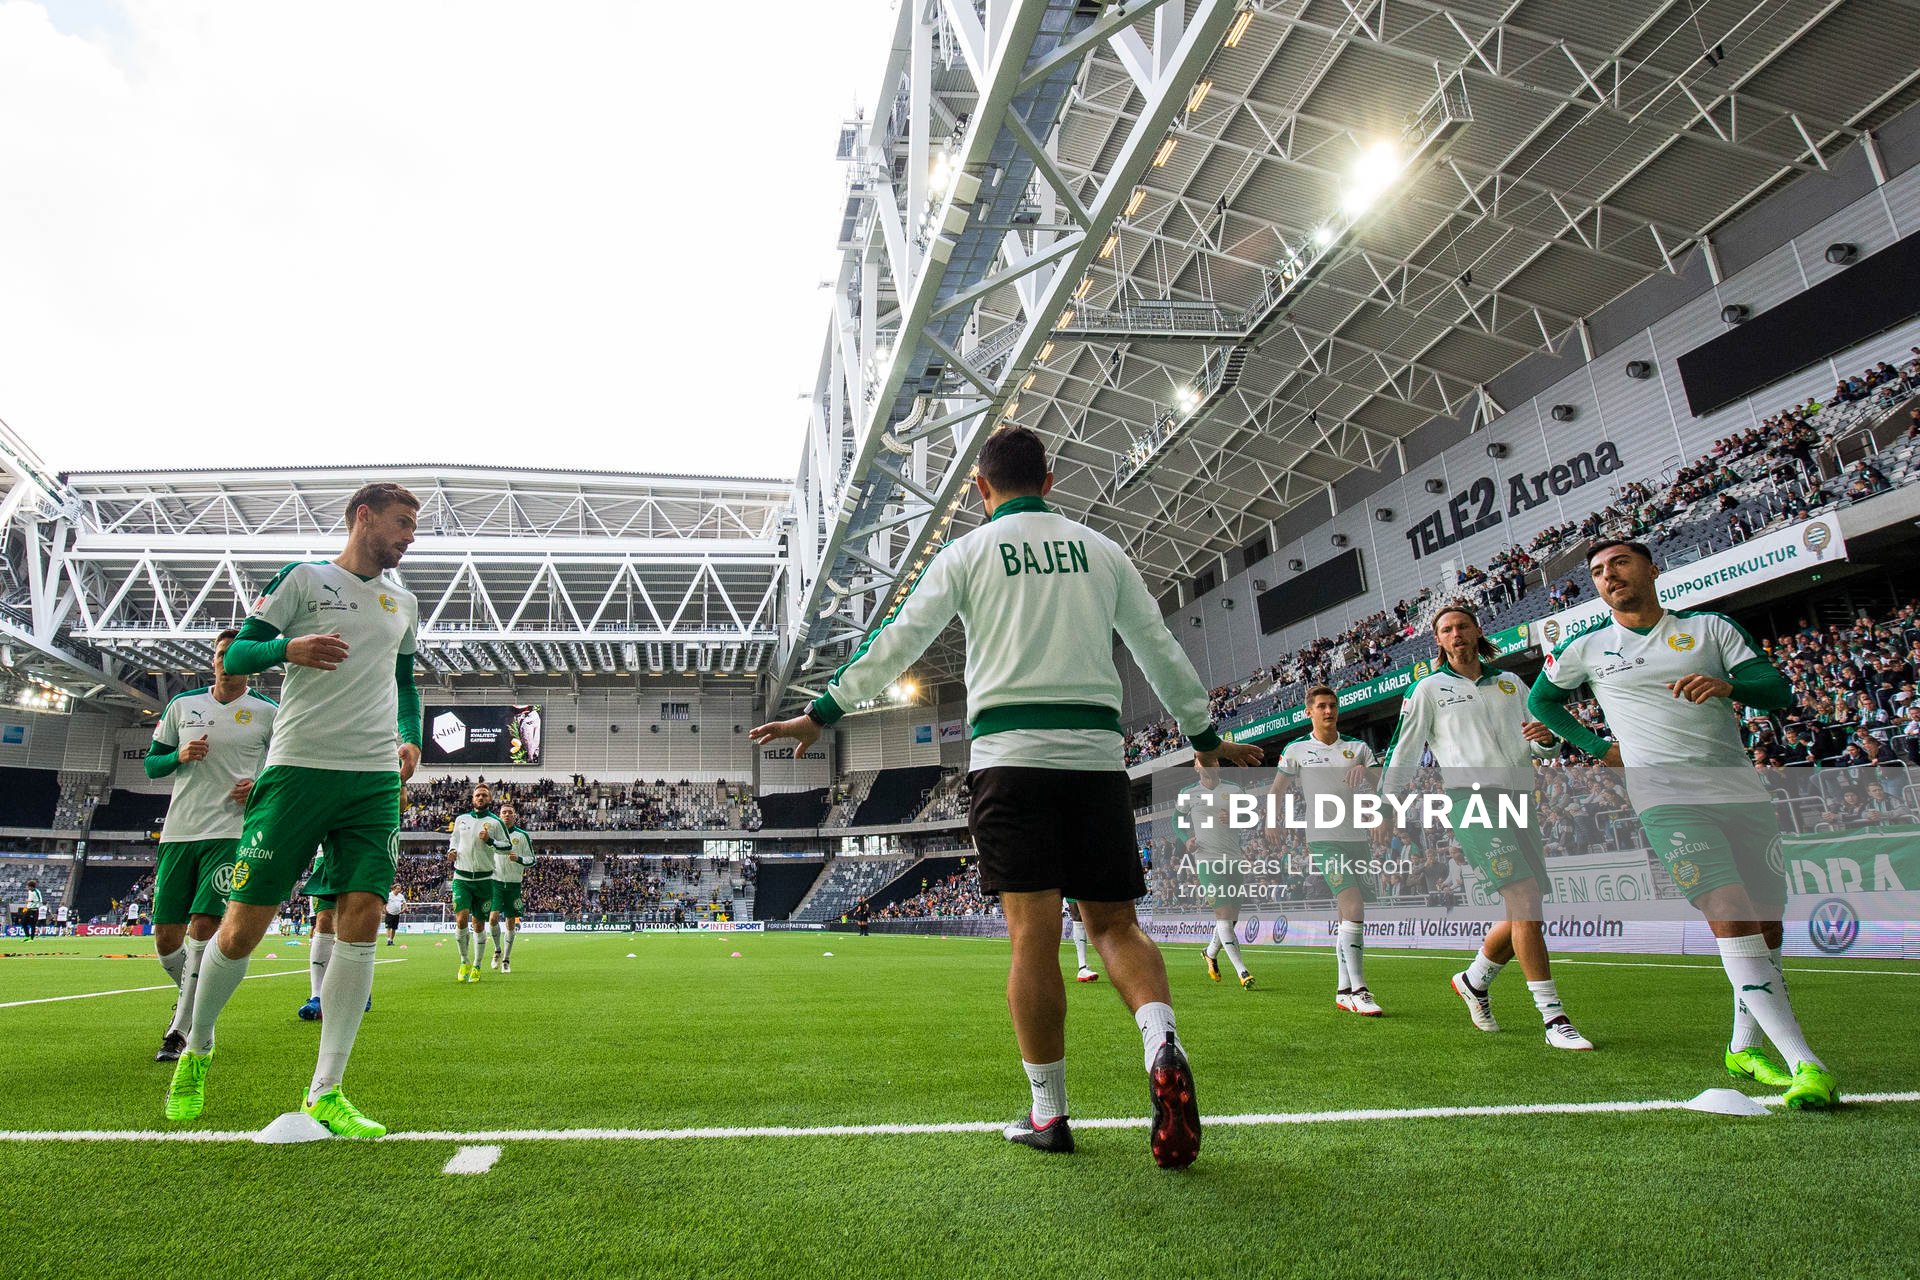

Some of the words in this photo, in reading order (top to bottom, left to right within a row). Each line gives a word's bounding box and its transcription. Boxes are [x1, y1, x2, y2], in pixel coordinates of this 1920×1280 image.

[1406, 477, 1503, 560] TELE2
[1508, 441, 1624, 518] Arena
[999, 540, 1090, 577] BAJEN
[1566, 618, 1587, 636] FÖR
[1659, 544, 1798, 603] SUPPORTERKULTUR
[1339, 686, 1373, 707] RESPEKT
[1378, 672, 1412, 694] KÄRLEK
[1234, 723, 1267, 742] HAMMARBY
[1266, 715, 1291, 732] FOTBOLL
[764, 747, 795, 760] TELE2
[1664, 841, 1710, 863] SAFECON
[565, 922, 592, 931] GRÖNE
[594, 921, 631, 931] JÄGAREN
[710, 922, 762, 931] INTERSPORT
[1398, 917, 1416, 936] till
